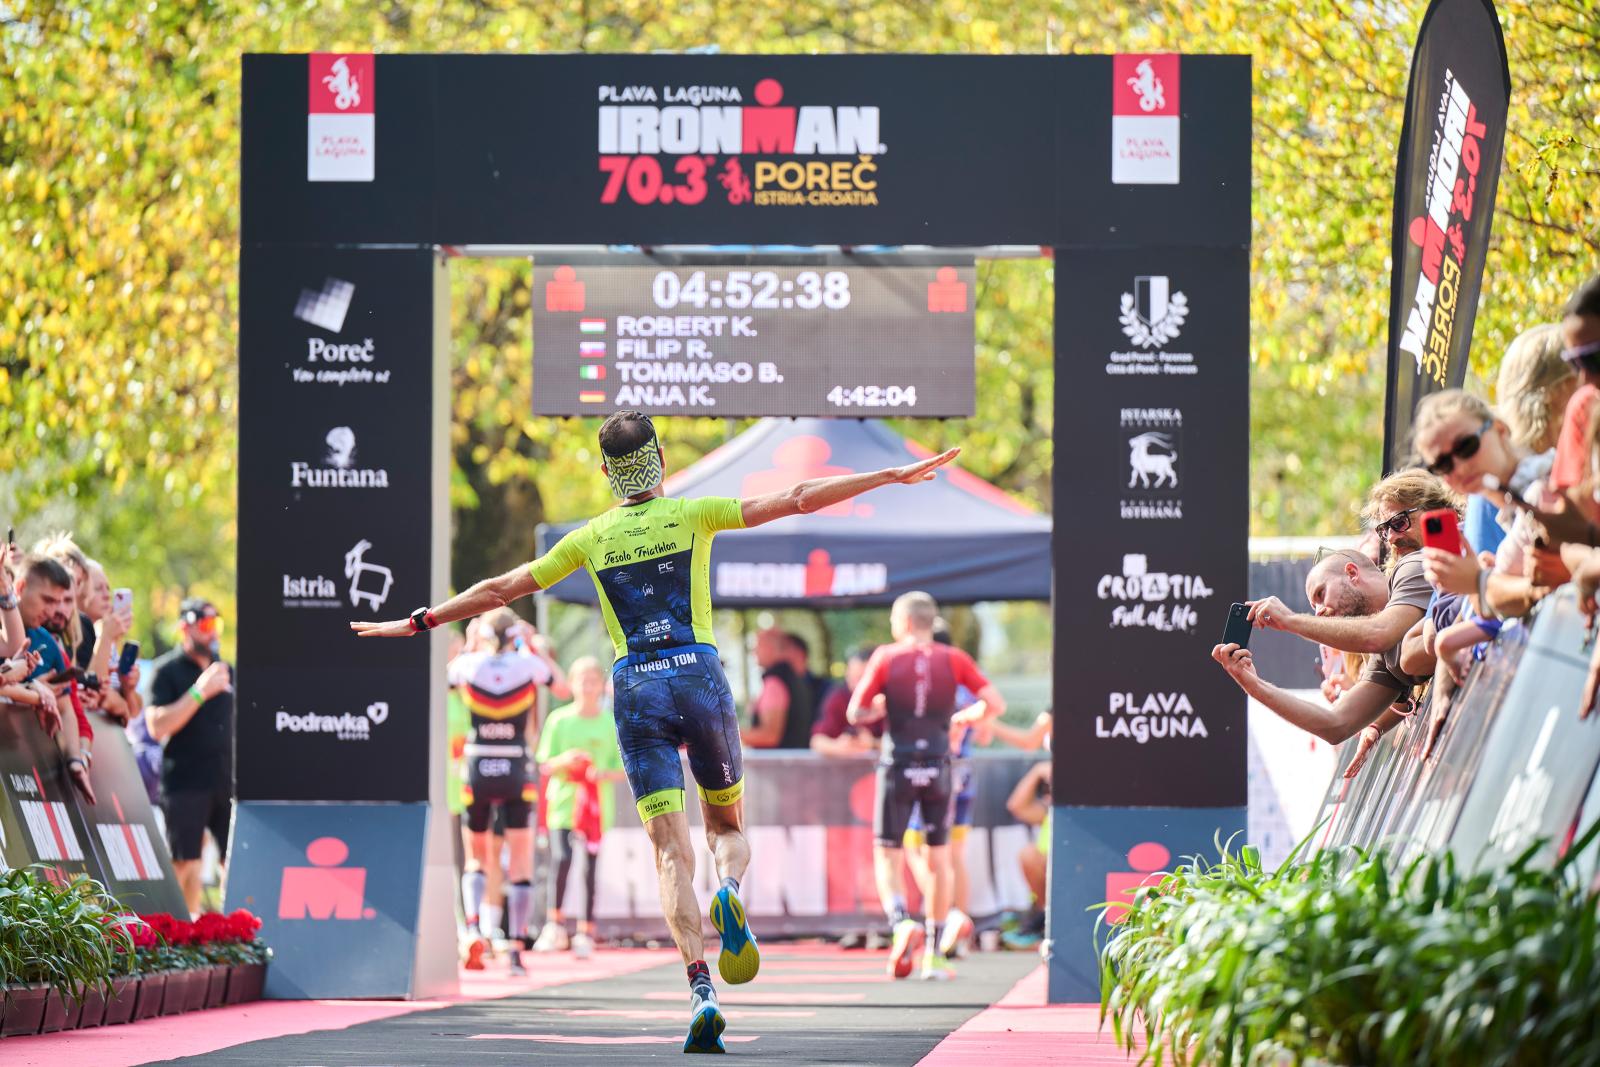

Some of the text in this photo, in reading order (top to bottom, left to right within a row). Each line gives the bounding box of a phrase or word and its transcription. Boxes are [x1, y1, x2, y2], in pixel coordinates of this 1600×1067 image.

[598, 85, 742, 106] PLAVA LAGUNA
[598, 79, 880, 154] IRONMAN
[599, 155, 708, 205] 70.3
[755, 154, 877, 191] POREČ
[652, 270, 851, 310] 04:52:38
[616, 316, 758, 337] ROBERT K.
[307, 337, 375, 362] Poreč
[616, 339, 713, 359] FILIP R.
[615, 362, 784, 383] TOMMASO B.
[614, 385, 716, 406] ANJA K.
[826, 386, 917, 406] 4:42:04
[291, 462, 389, 488] Funtana
[634, 541, 677, 558] Triathlon
[657, 561, 675, 572] PC
[283, 574, 336, 597] Istria
[644, 620, 659, 630] san
[644, 624, 672, 635] marco
[634, 652, 698, 673] TURBO TOM
[1109, 692, 1194, 715] PLAVA
[276, 711, 370, 732] Podravka
[1096, 715, 1208, 744] LAGUNA
[644, 799, 670, 813] Bison
